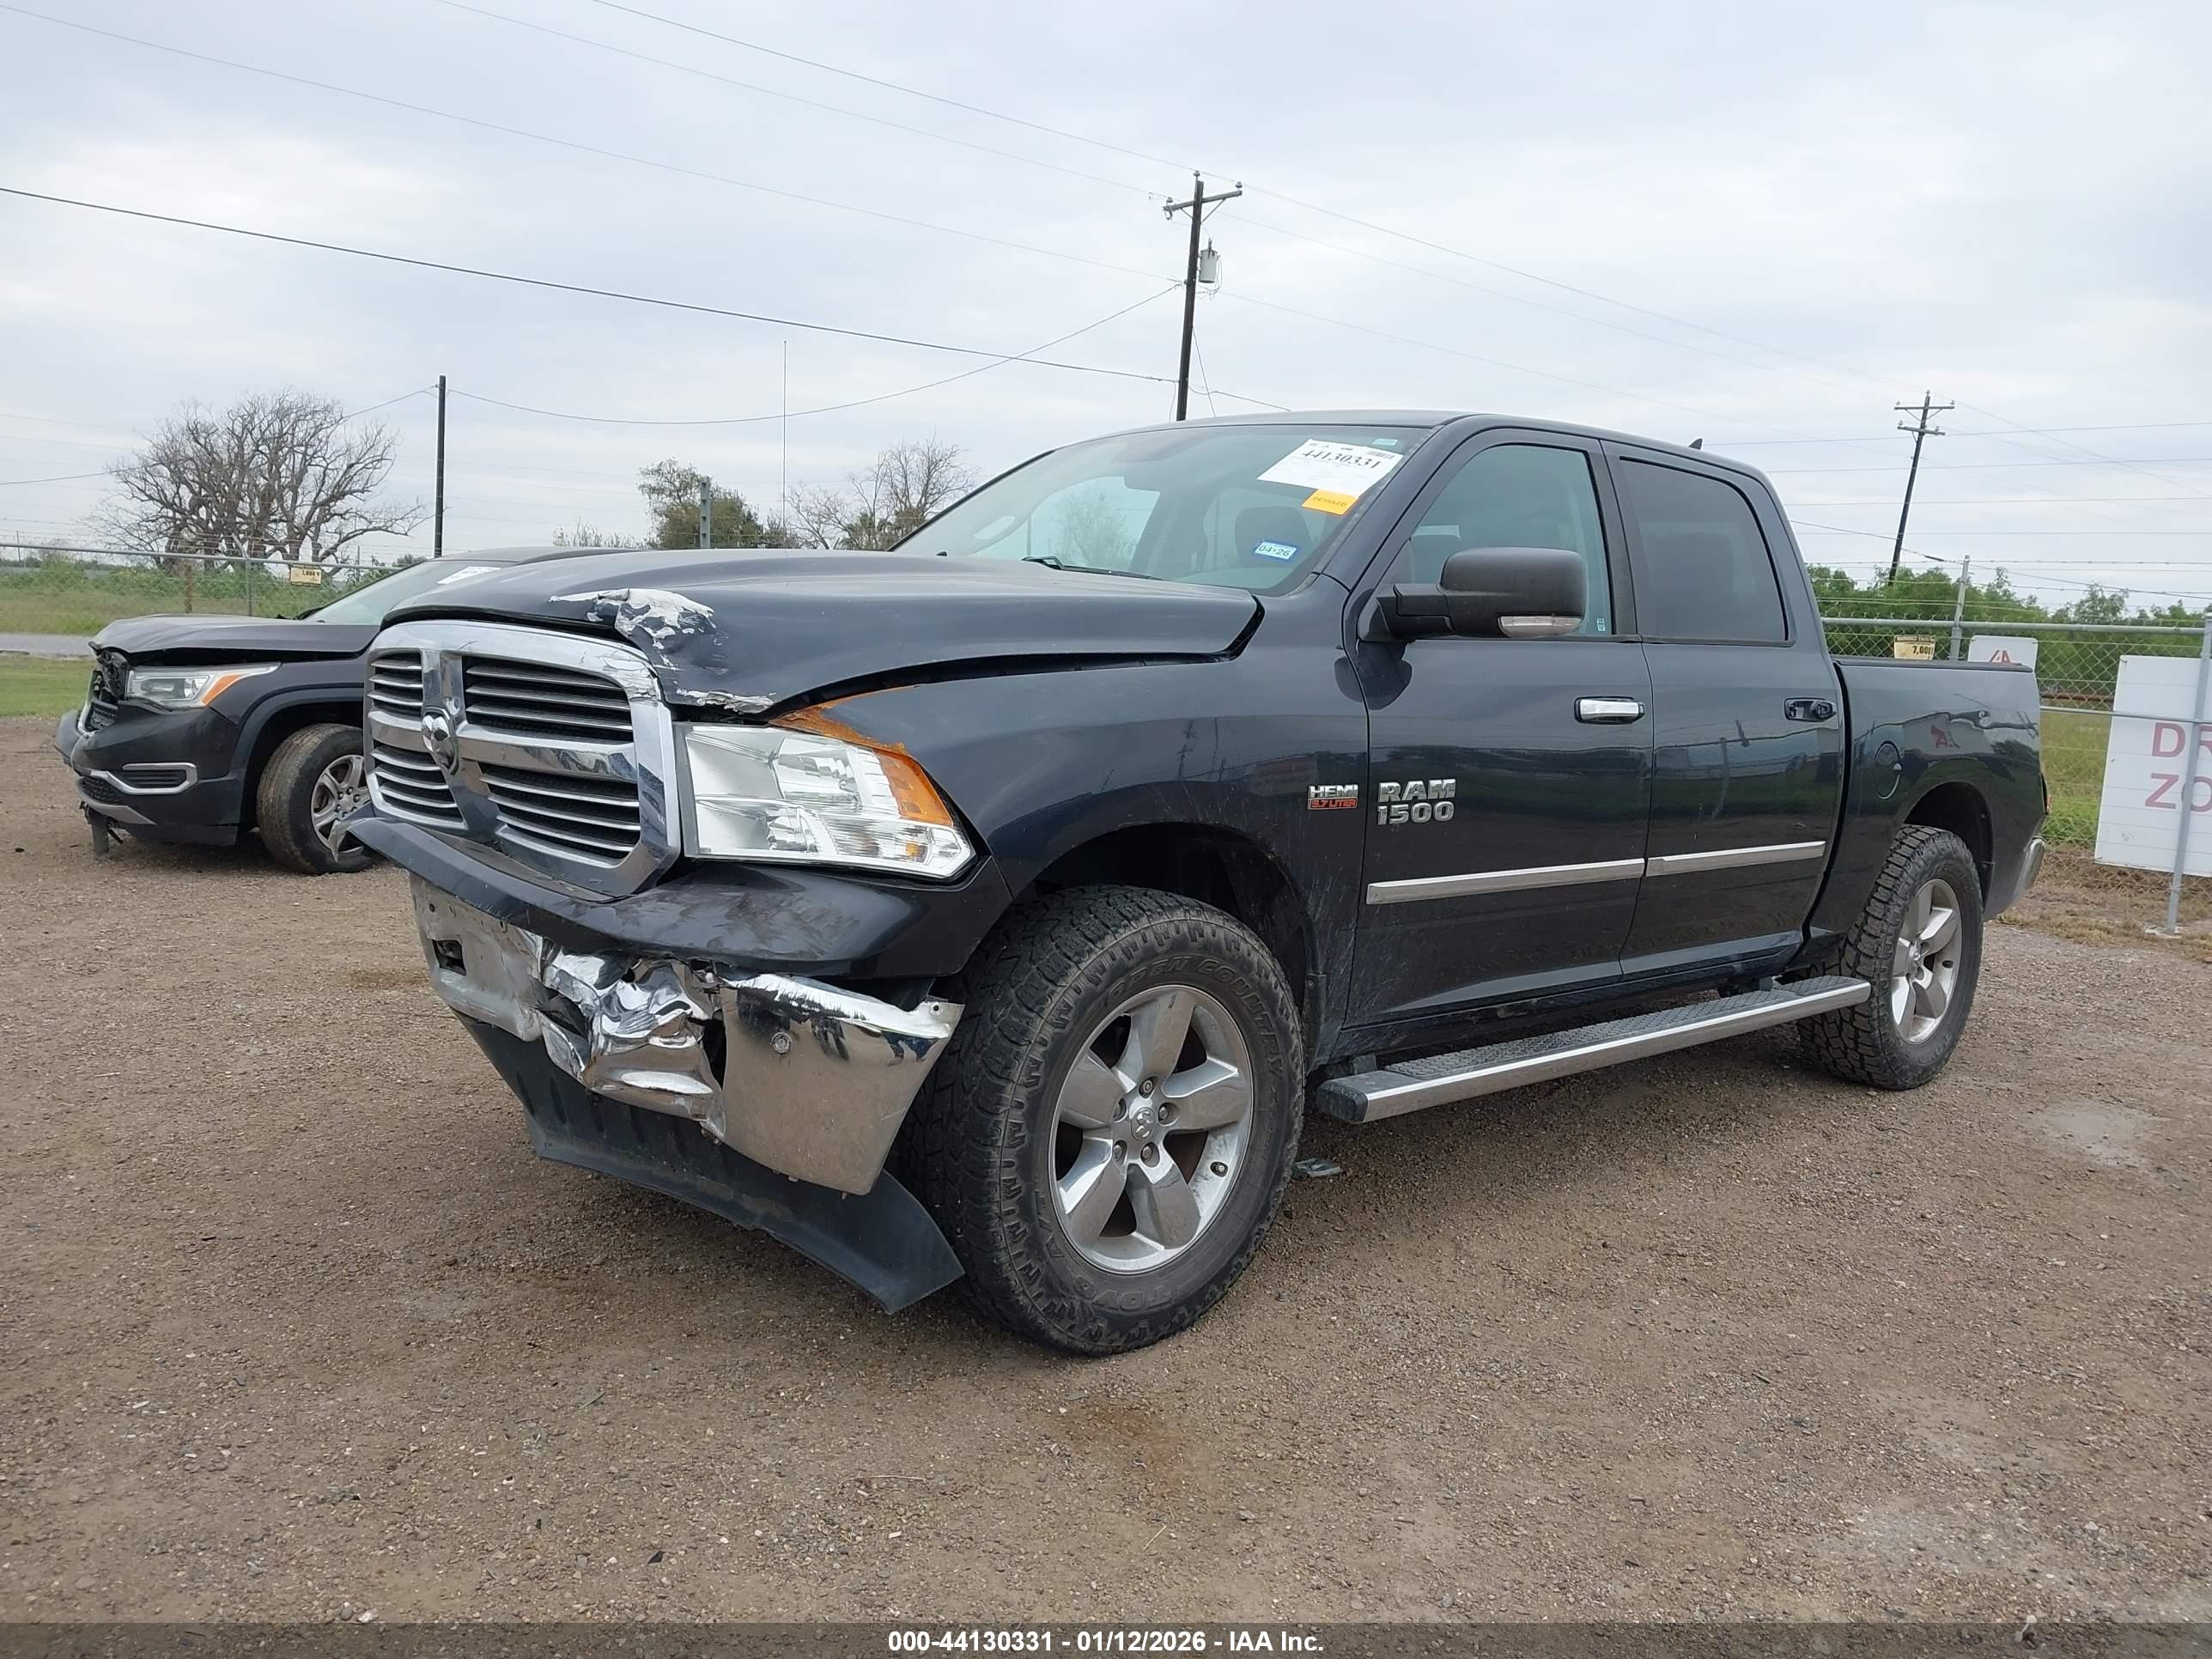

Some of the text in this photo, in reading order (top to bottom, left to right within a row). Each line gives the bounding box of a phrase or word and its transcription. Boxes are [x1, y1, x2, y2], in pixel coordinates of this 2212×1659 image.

[1302, 449, 1381, 468] 44130331
[1308, 785, 1358, 798] HEMI
[1378, 779, 1456, 803] RAM
[1329, 799, 1357, 808] LITER
[1377, 801, 1455, 825] 1500
[1106, 956, 1283, 1079] OPEN COUNTRY
[1073, 1275, 1172, 1312] TOYO
